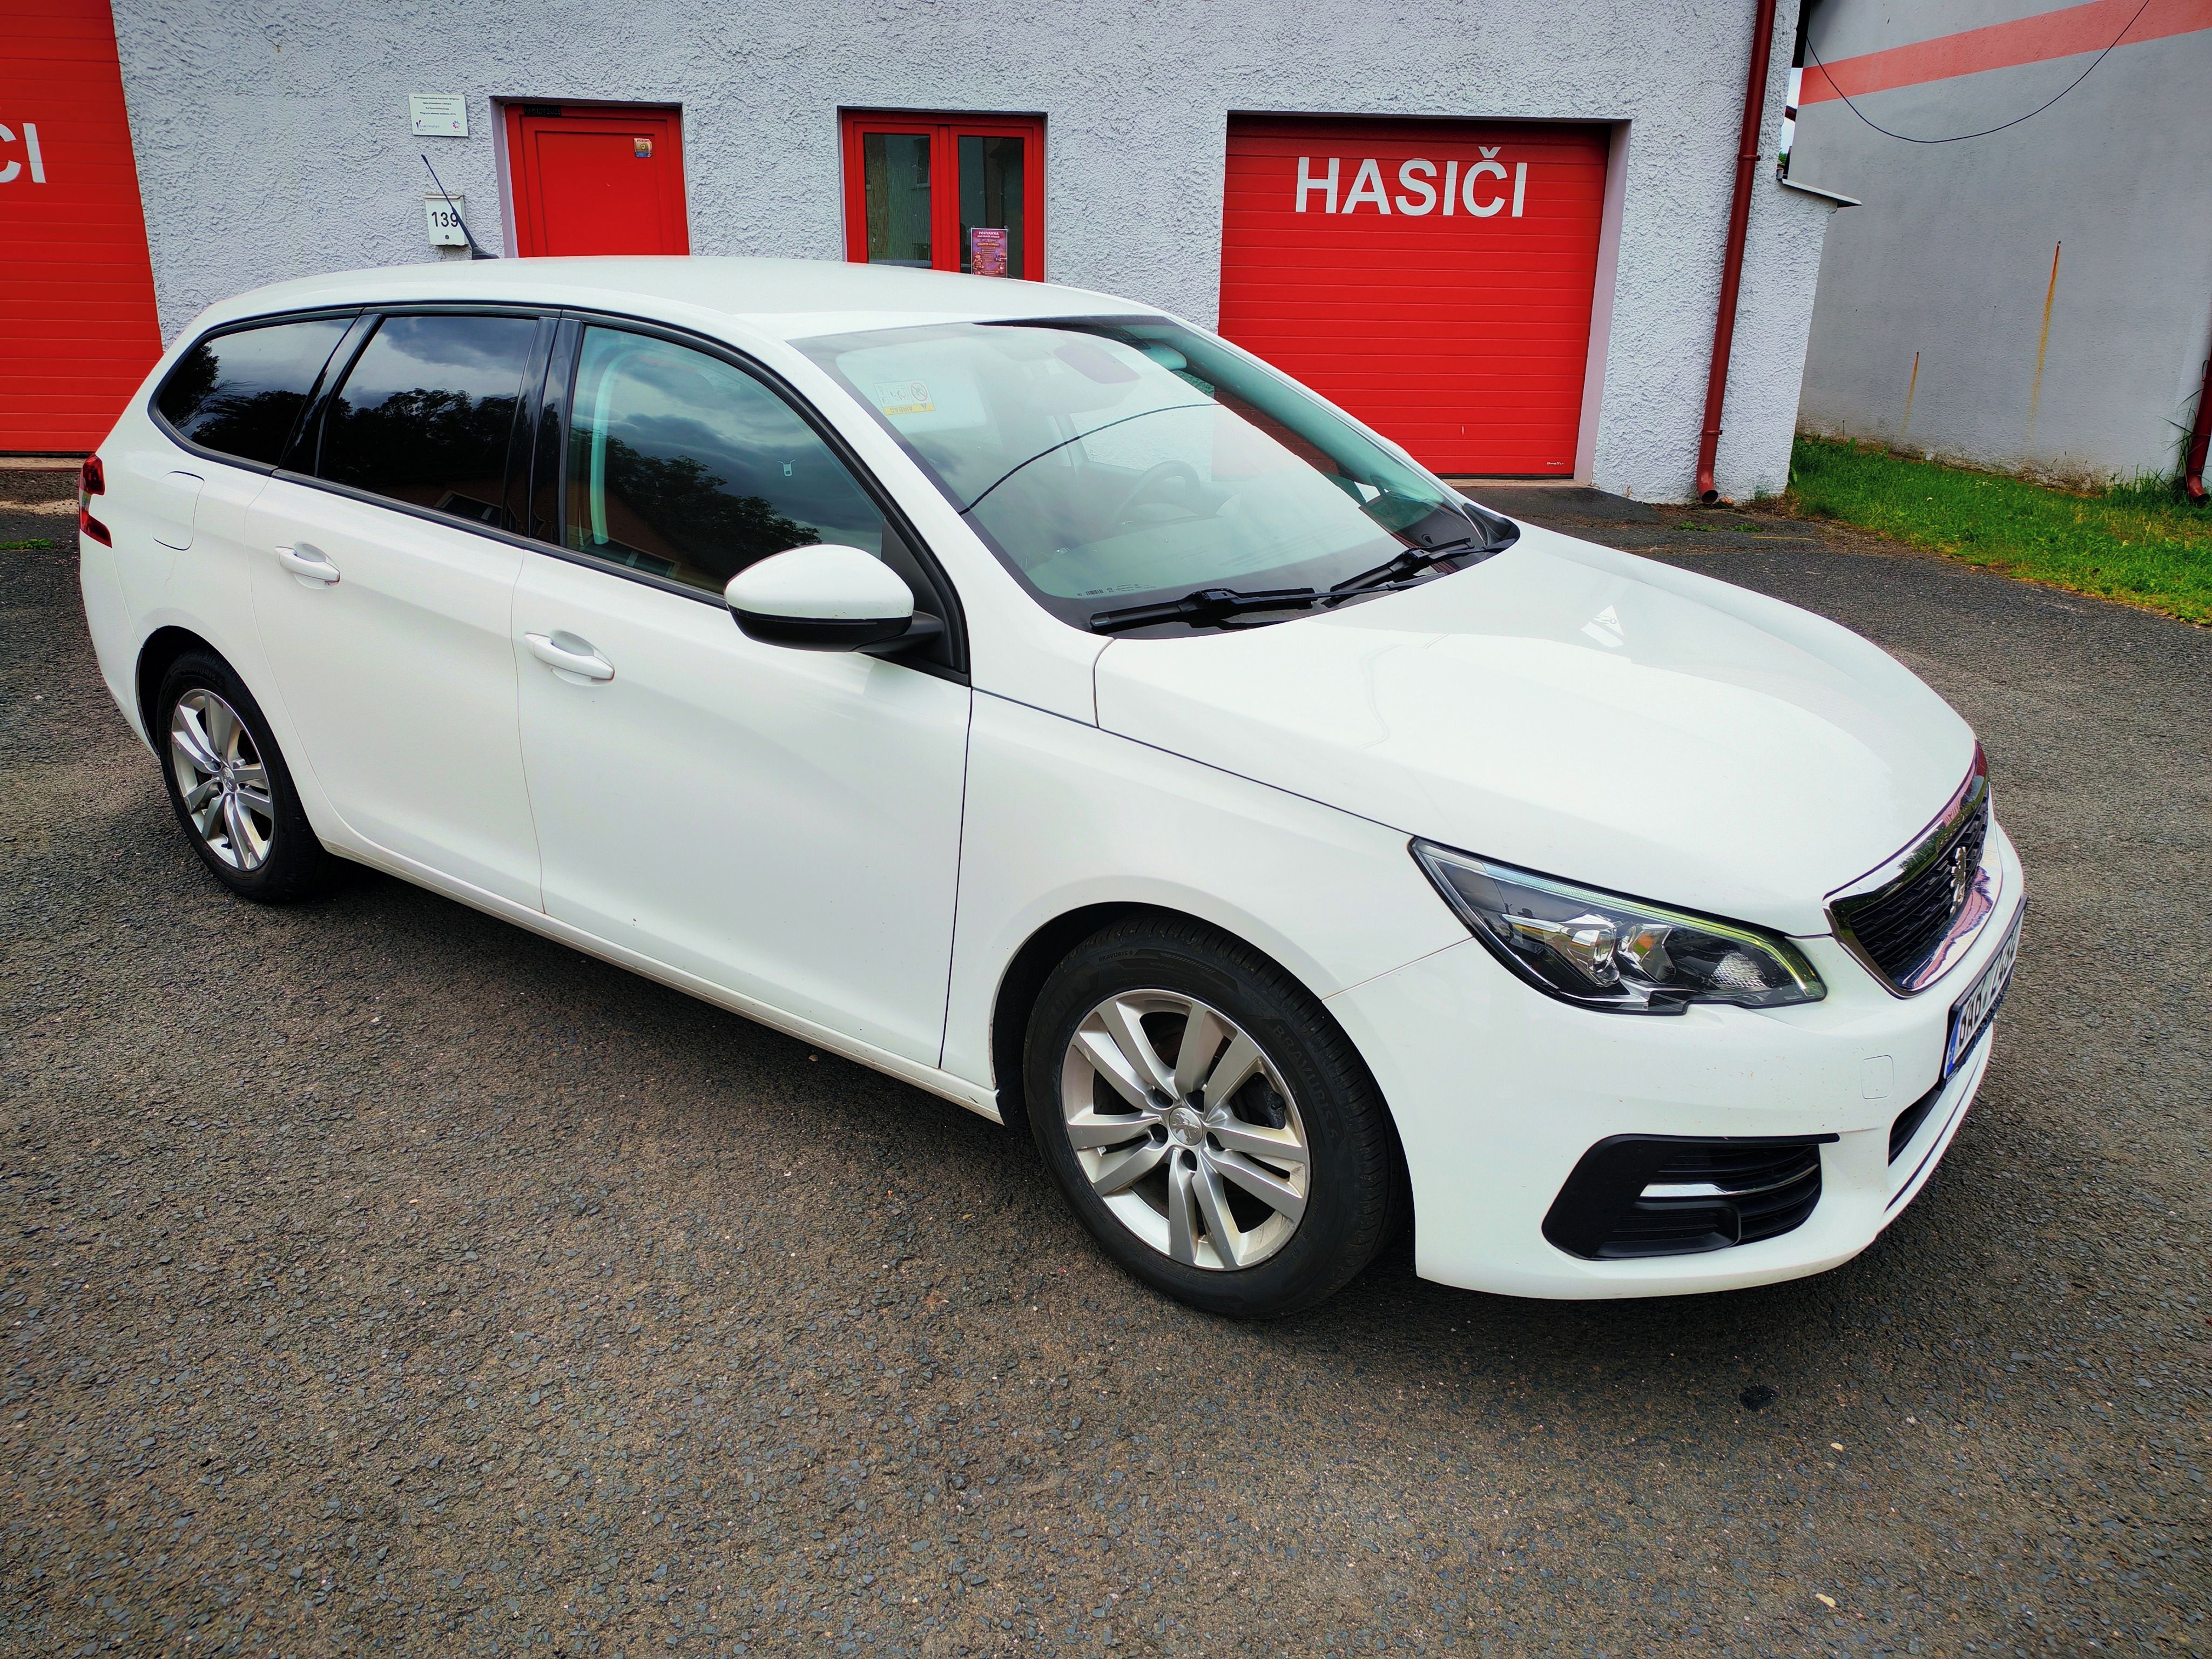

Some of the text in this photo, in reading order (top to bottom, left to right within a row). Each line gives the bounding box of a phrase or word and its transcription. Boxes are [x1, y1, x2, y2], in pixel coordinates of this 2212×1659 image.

[1295, 146, 1528, 218] HASIČI
[431, 211, 458, 227] 139
[1098, 950, 1128, 962] BRAVURIS
[1273, 1024, 1333, 1120] BRAVURIS
